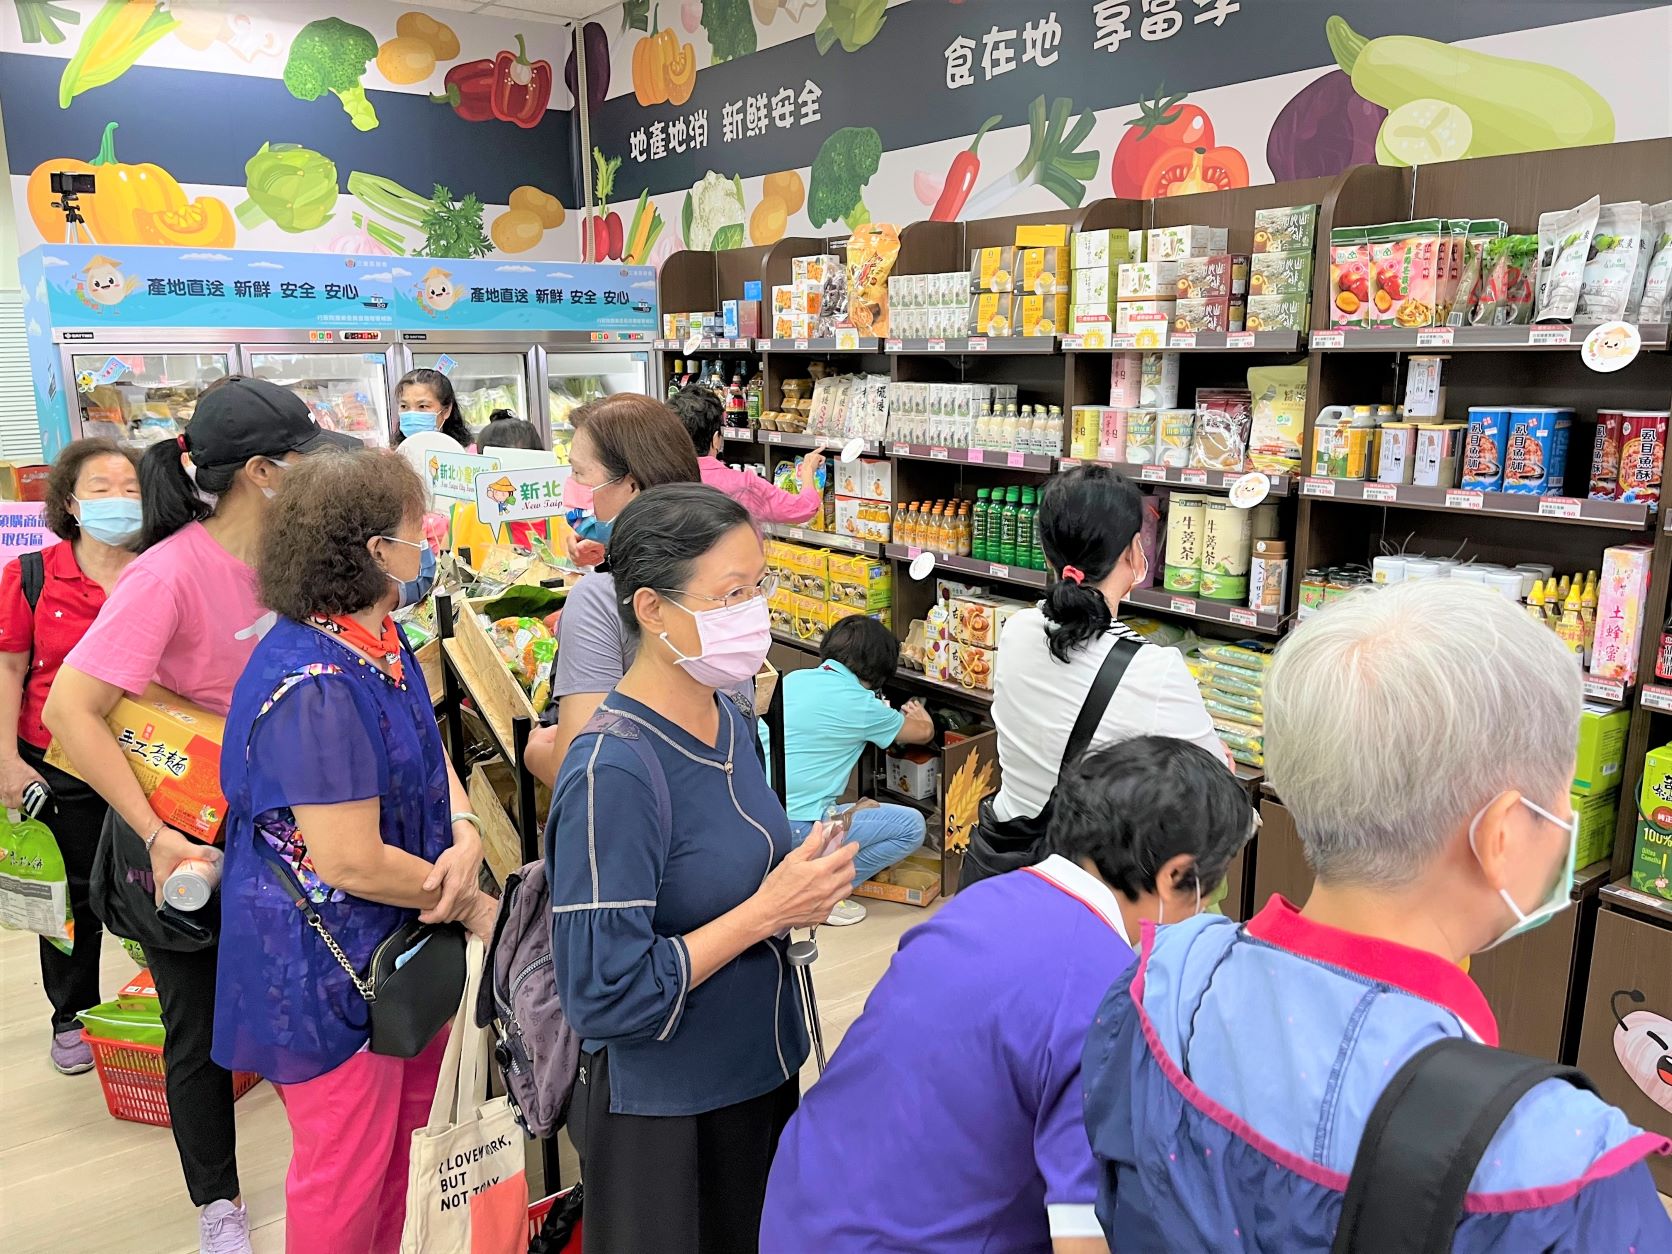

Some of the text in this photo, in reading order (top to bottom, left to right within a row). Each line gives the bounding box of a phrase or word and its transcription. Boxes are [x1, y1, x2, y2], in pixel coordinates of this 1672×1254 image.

[944, 11, 1063, 90] 食在地
[629, 79, 823, 163] 地產地消 新鮮安全
[147, 278, 359, 301] 產地直送 新鮮 安全 安心
[470, 287, 631, 305] 產地直送 新鮮 安全 安心
[1510, 423, 1527, 472] 虱目魚脯
[1635, 428, 1656, 481] 虱目魚酥
[520, 480, 562, 501] 新北
[521, 501, 541, 510] New
[1, 533, 43, 546] 取貨區
[1180, 516, 1195, 561] 牛蒡茶
[1205, 519, 1216, 565] 牛蒡茶
[1605, 605, 1624, 662] 土蜂蜜
[1643, 827, 1672, 848] 100%
[446, 1148, 480, 1171] LOVE
[440, 1171, 467, 1193] BUT
[440, 1190, 469, 1212] NOT
